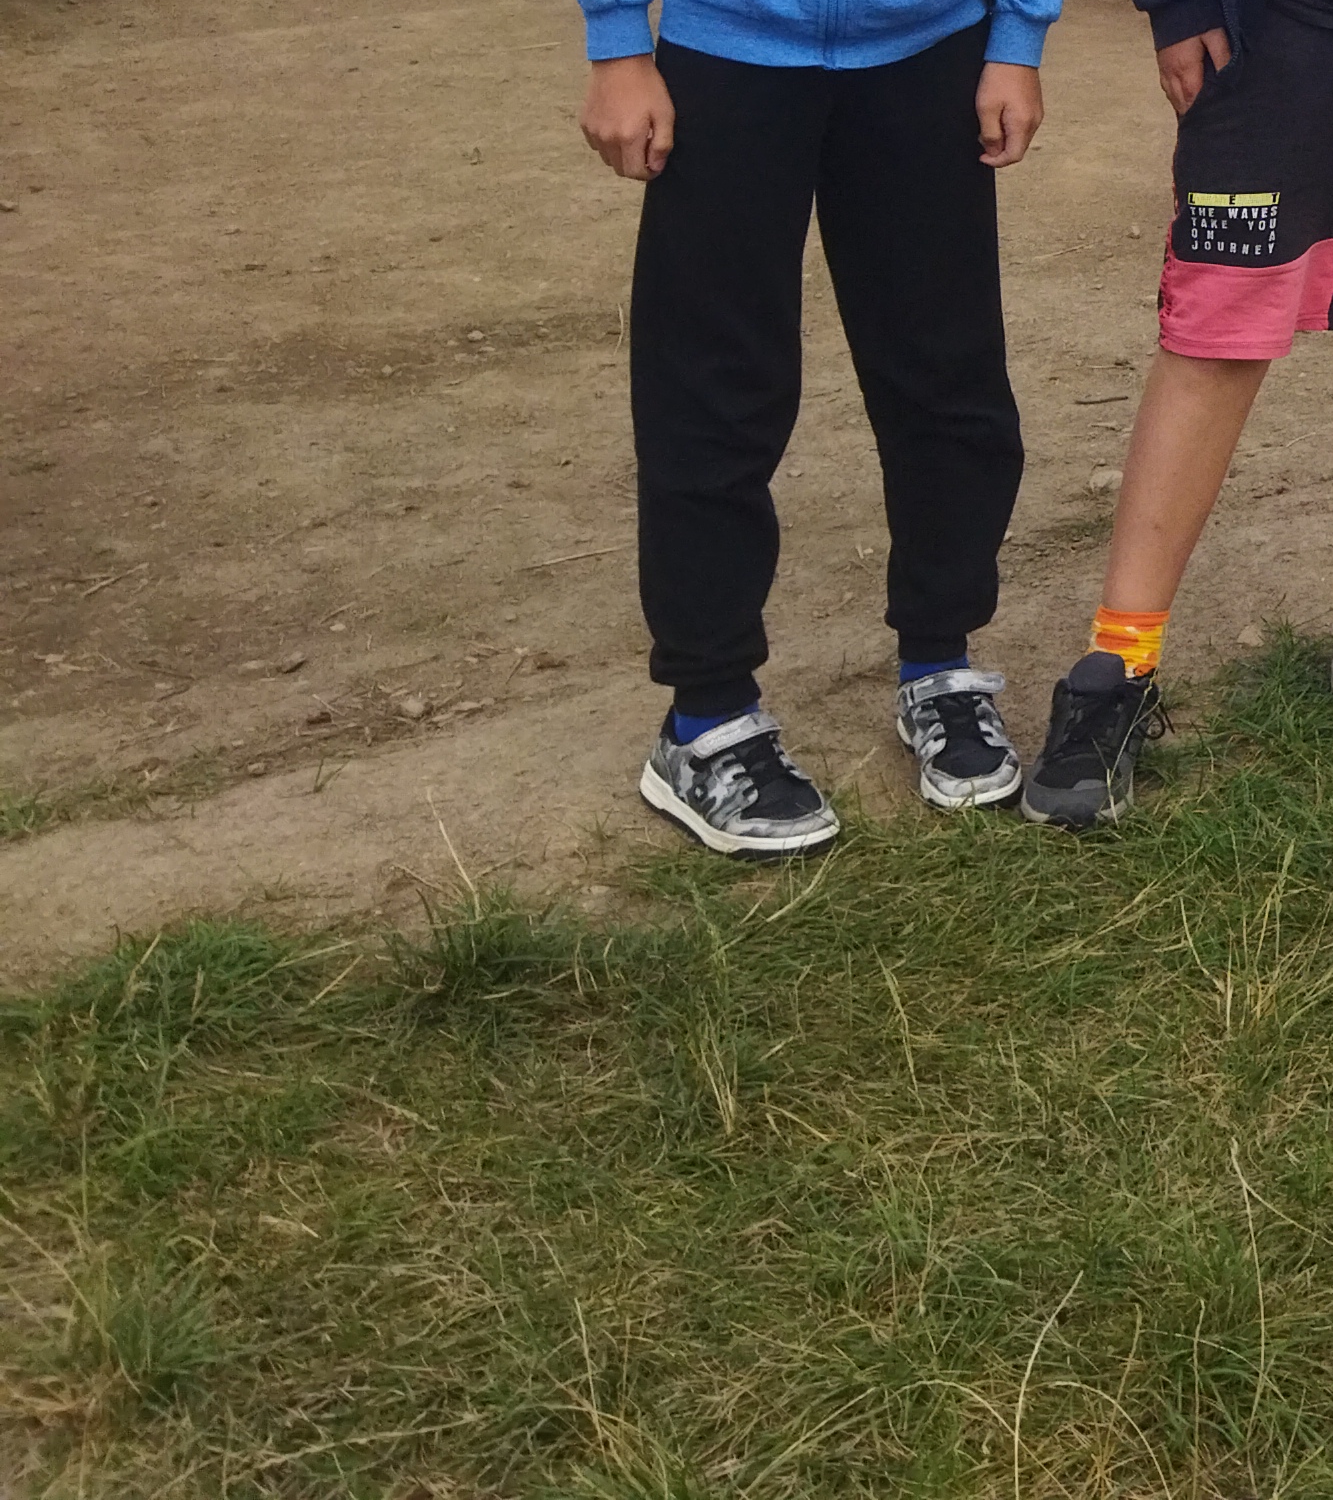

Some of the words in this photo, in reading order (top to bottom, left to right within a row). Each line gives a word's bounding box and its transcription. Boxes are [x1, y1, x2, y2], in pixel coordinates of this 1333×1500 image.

[1190, 207, 1215, 218] THE
[1228, 206, 1278, 219] WAVES
[1191, 217, 1228, 230] TAKE
[1248, 218, 1277, 231] YOU
[1269, 230, 1276, 241] A
[1191, 241, 1275, 255] JOURNEY
